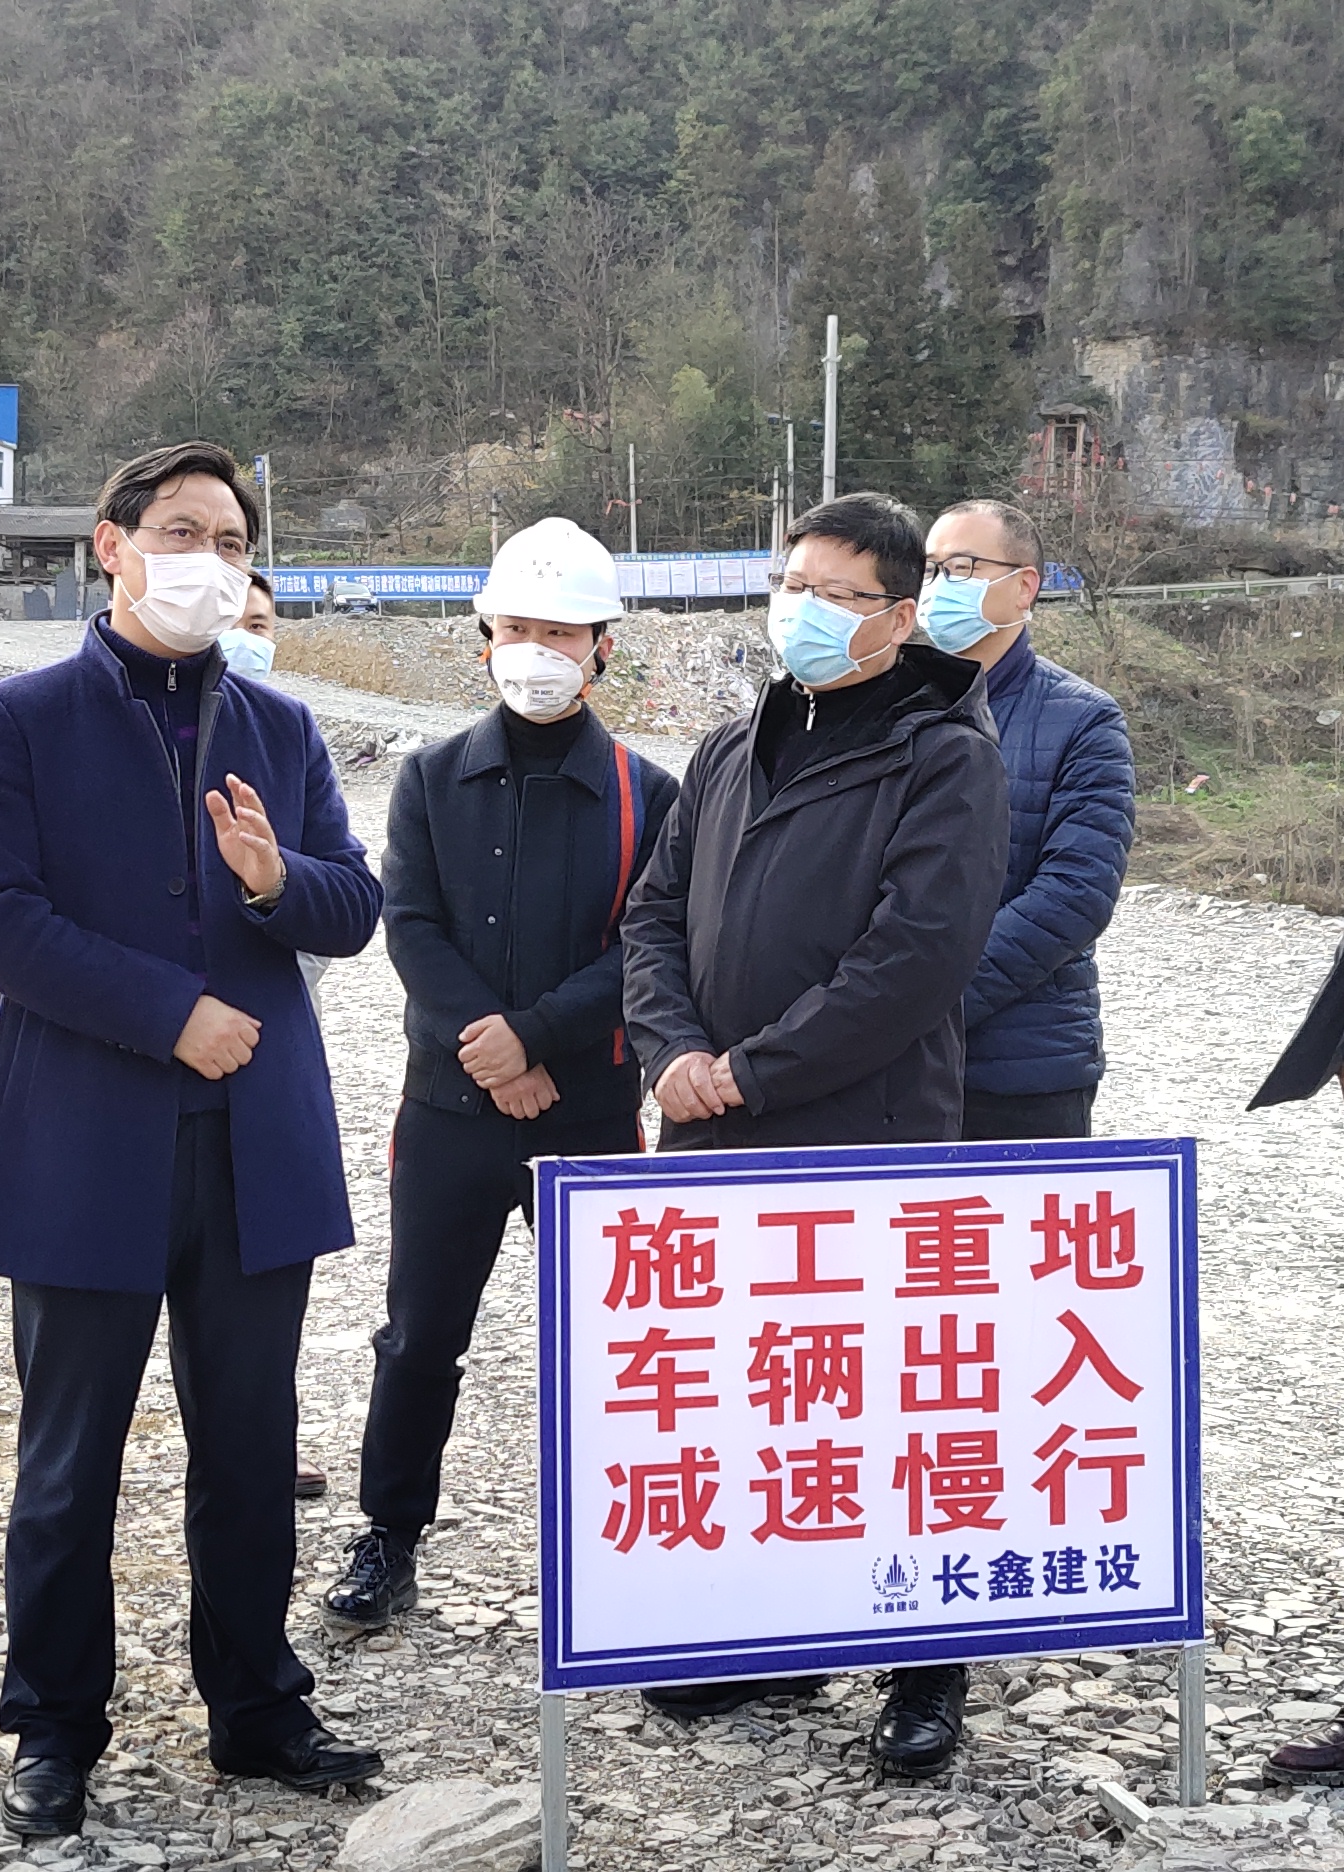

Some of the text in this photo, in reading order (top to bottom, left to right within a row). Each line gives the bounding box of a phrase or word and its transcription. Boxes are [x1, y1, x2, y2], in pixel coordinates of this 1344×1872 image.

[602, 1191, 1144, 1311] 施工重地
[606, 1309, 1144, 1433] 车辆出入
[602, 1423, 1144, 1554] 减速慢行
[872, 1600, 919, 1614] 长鑫建设
[932, 1544, 1141, 1605] 长鑫建设
